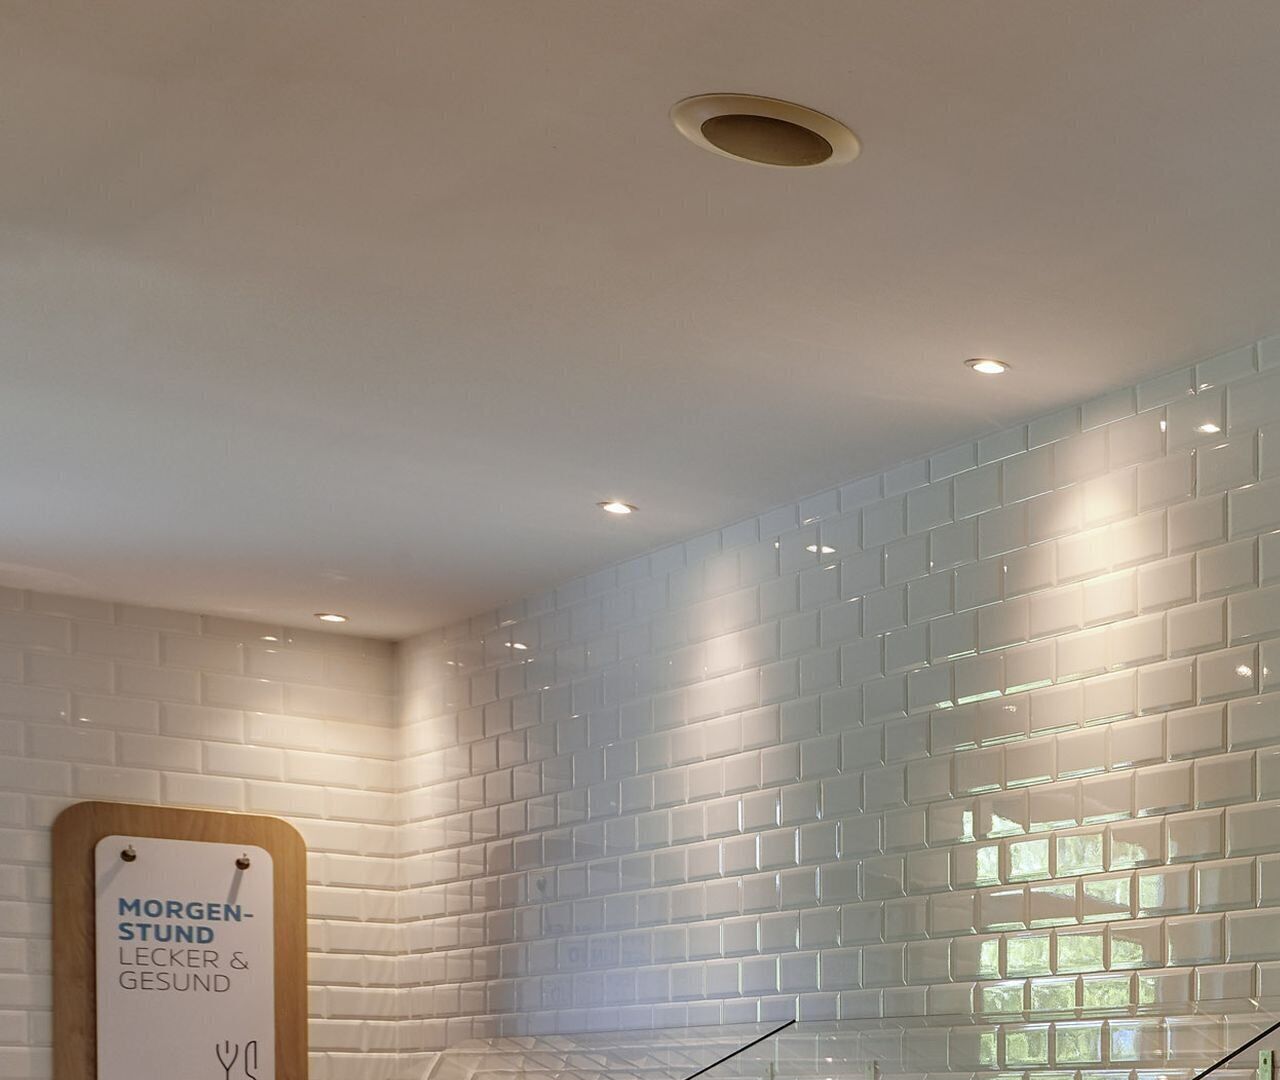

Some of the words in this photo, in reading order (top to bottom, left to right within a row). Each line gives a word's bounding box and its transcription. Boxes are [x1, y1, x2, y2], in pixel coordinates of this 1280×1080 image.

[118, 897, 254, 922] MORGEN-
[118, 922, 214, 944] STUND
[119, 947, 219, 970] LECKER
[230, 951, 250, 970] &
[119, 970, 231, 993] GESUND
